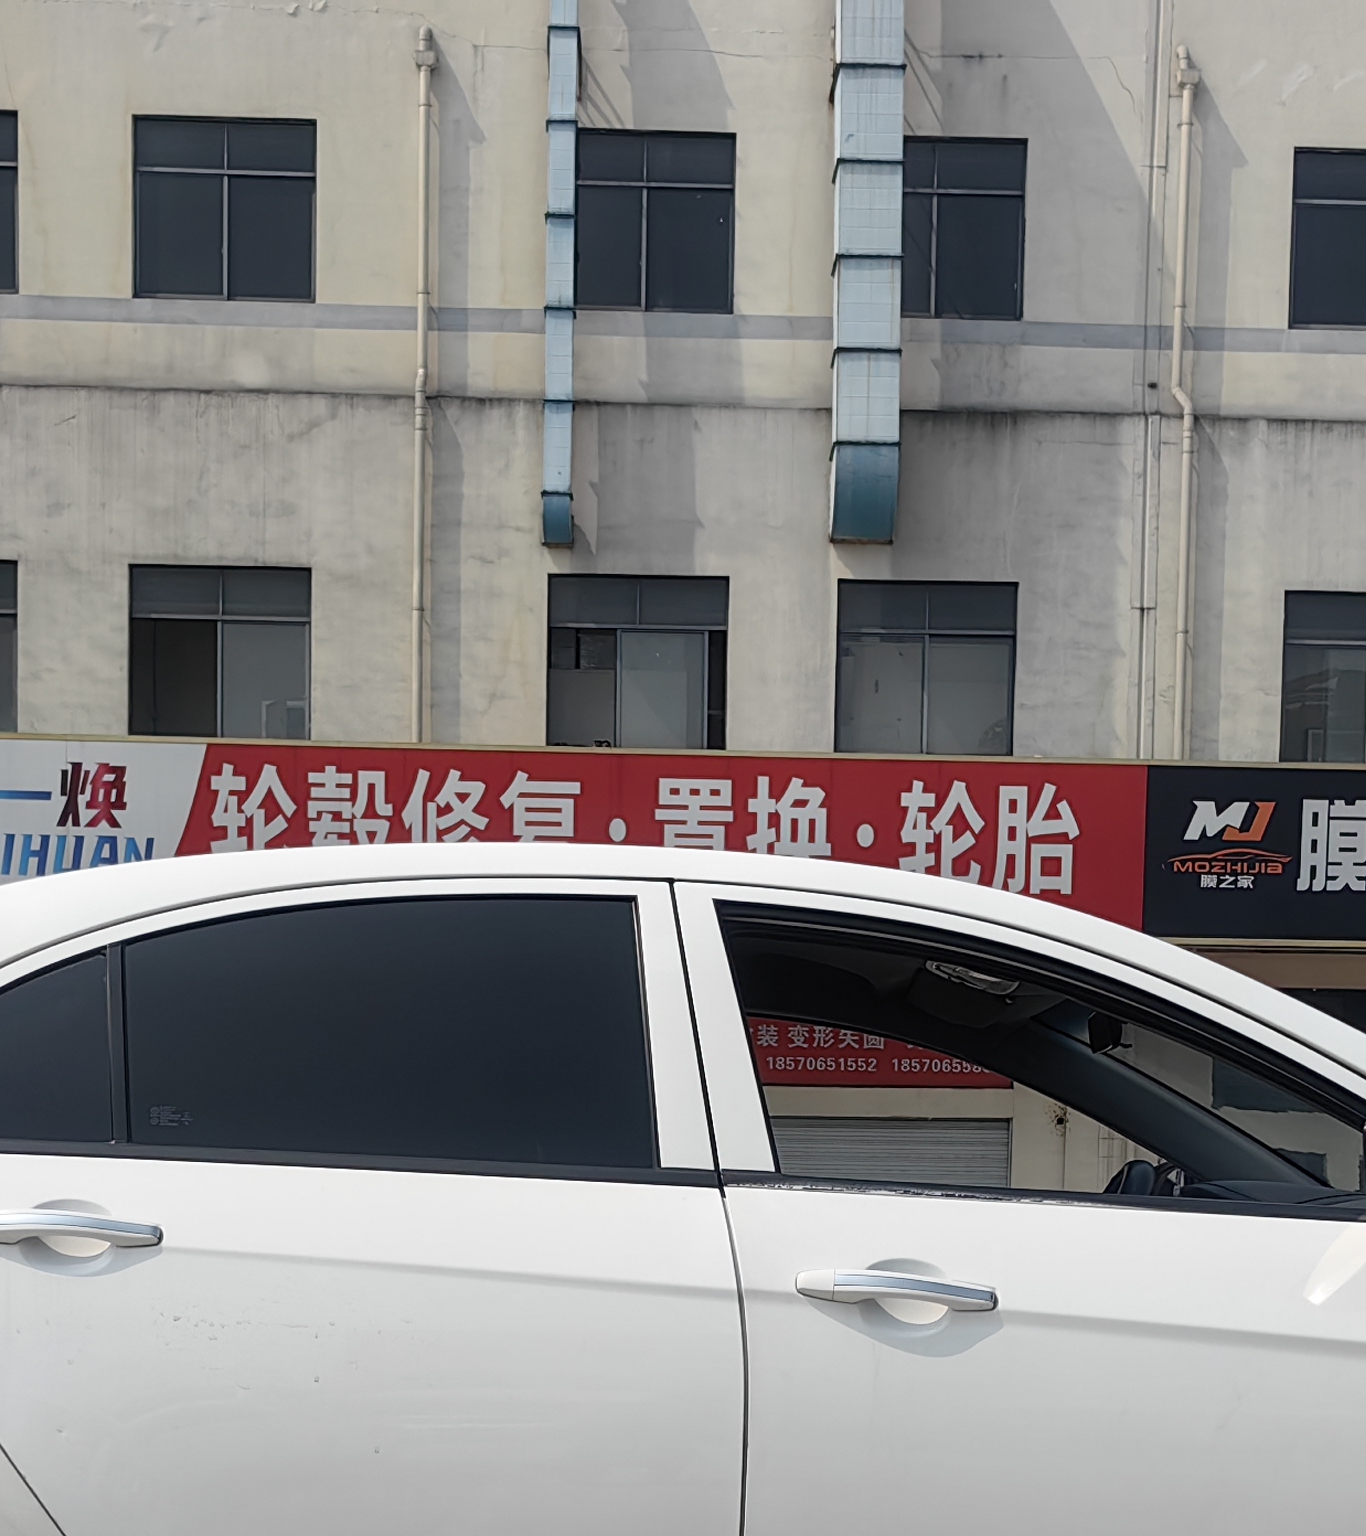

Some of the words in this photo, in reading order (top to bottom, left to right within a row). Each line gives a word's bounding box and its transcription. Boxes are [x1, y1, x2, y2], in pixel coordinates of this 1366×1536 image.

[1200, 874, 1255, 889] 膜之家
[749, 1025, 779, 1047] 装
[766, 1056, 877, 1072] 18570651552
